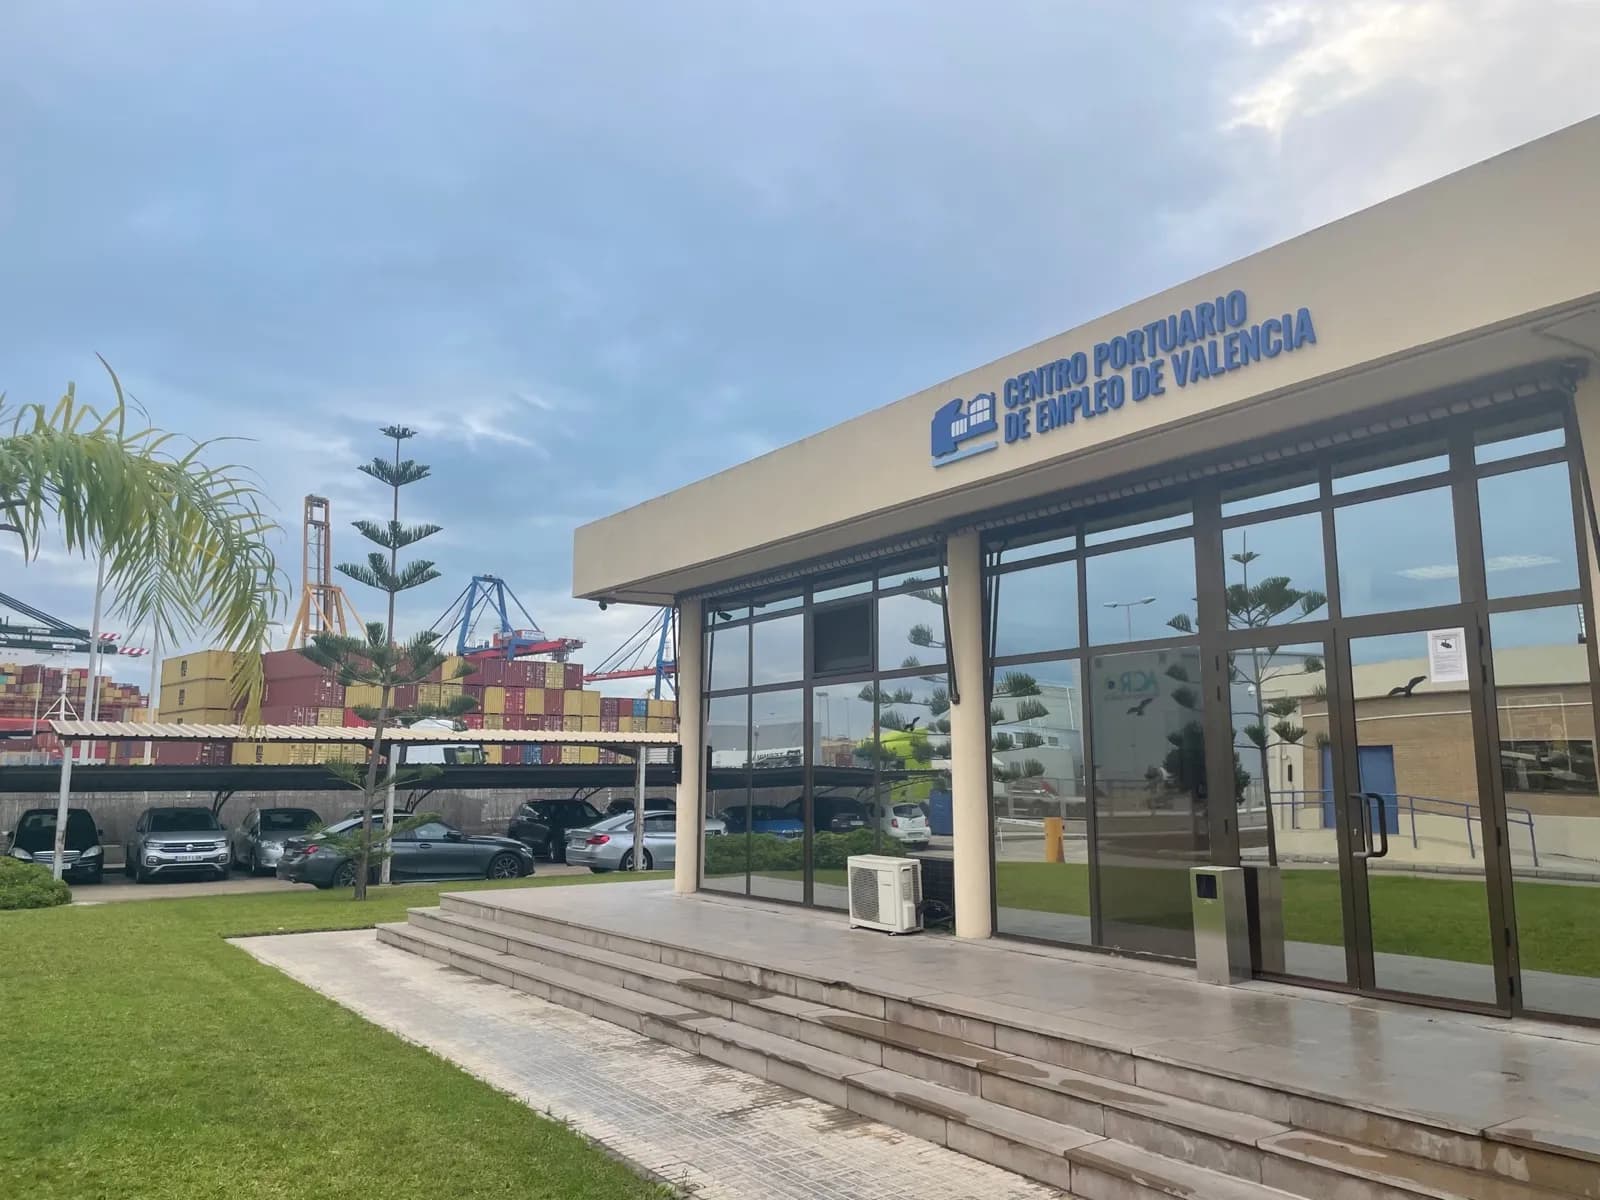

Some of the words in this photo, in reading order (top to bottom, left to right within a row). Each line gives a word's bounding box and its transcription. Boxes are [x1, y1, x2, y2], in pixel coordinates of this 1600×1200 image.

[1003, 351, 1087, 409] CENTRO
[1093, 289, 1247, 377] PORTUARIO
[1004, 408, 1031, 444] DE
[1036, 374, 1125, 434] EMPLEO
[1131, 358, 1165, 402] DE
[1171, 307, 1317, 387] VALENCIA
